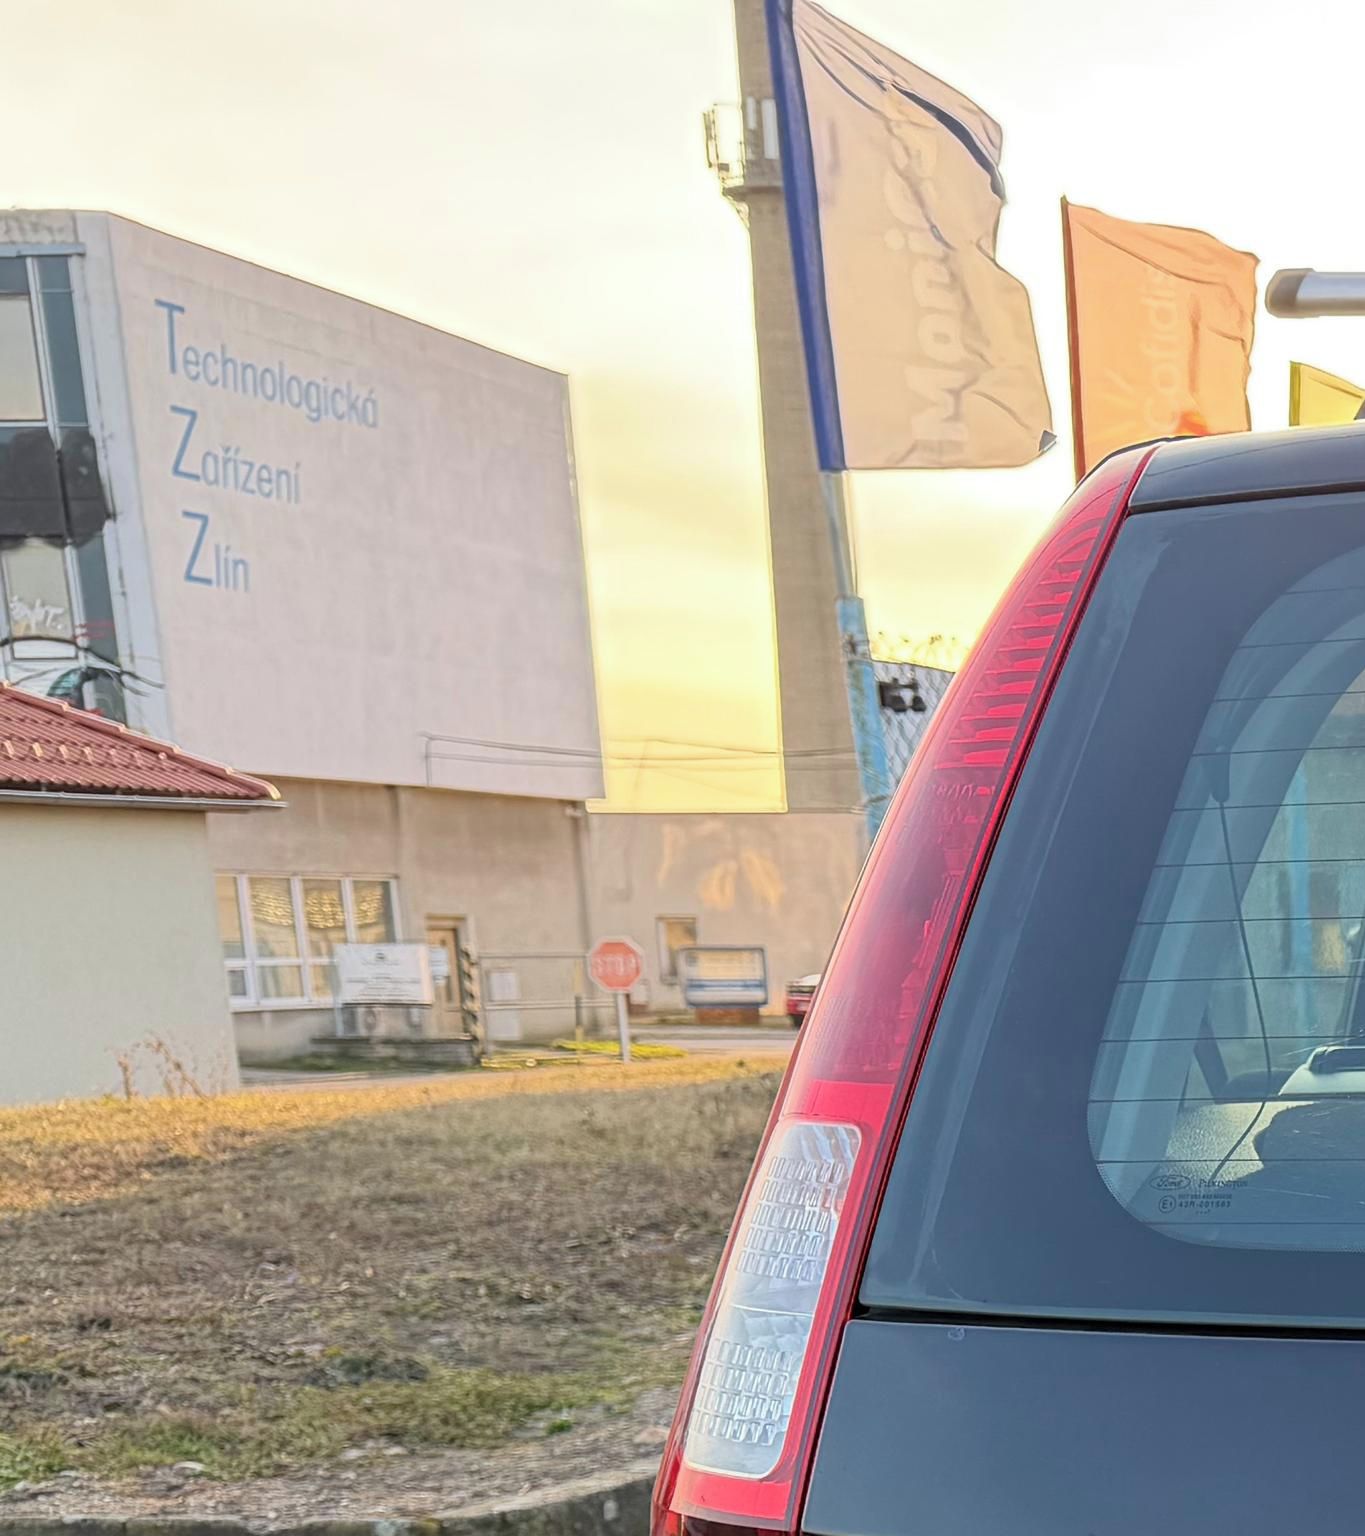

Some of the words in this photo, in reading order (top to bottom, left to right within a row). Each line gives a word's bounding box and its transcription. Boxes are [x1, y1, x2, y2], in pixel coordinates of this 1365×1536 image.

[154, 298, 379, 429] Technologická
[169, 404, 301, 504] Zařízení
[181, 509, 250, 593] Zlín
